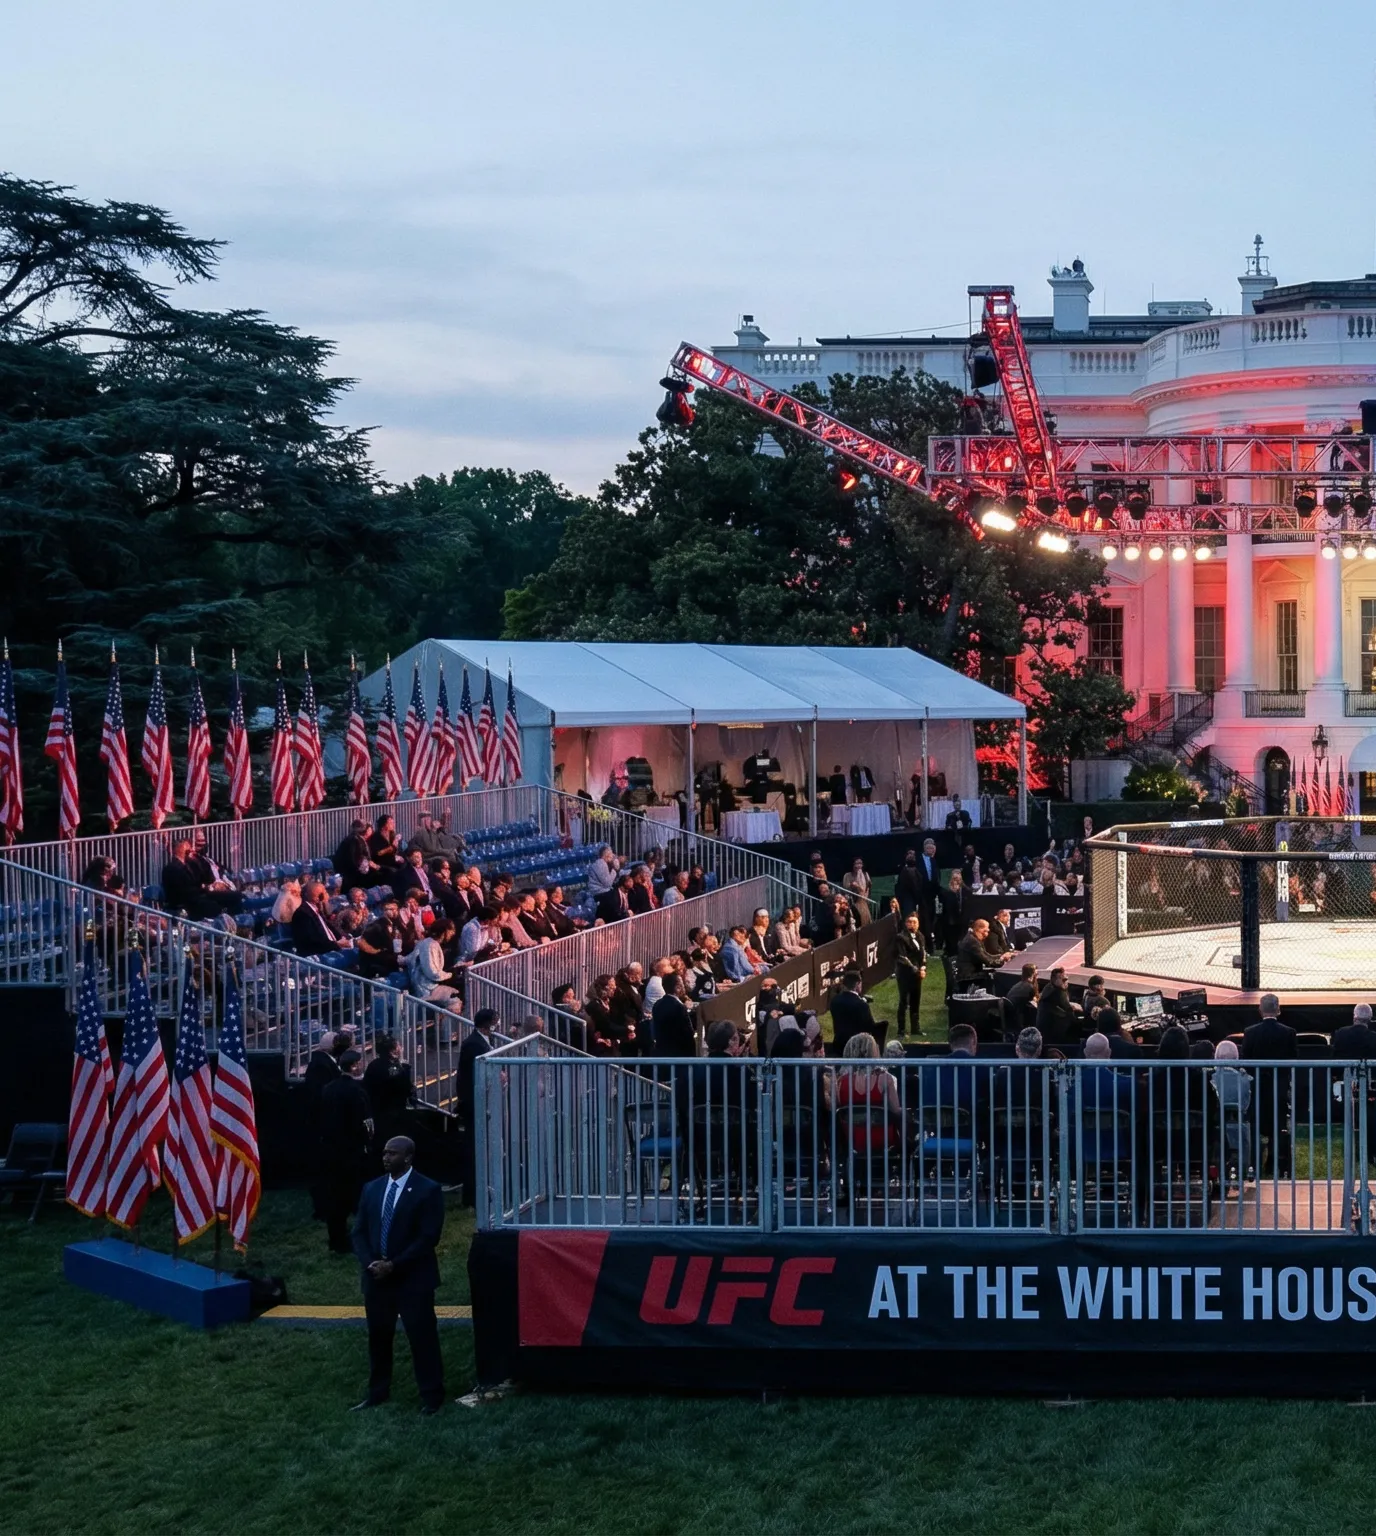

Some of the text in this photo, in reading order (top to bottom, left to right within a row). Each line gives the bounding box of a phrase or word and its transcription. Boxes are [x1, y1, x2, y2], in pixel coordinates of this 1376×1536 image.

[640, 1256, 836, 1325] UFC
[867, 1265, 928, 1319] AT
[943, 1265, 1040, 1320] THE
[1056, 1265, 1223, 1320] WHITE
